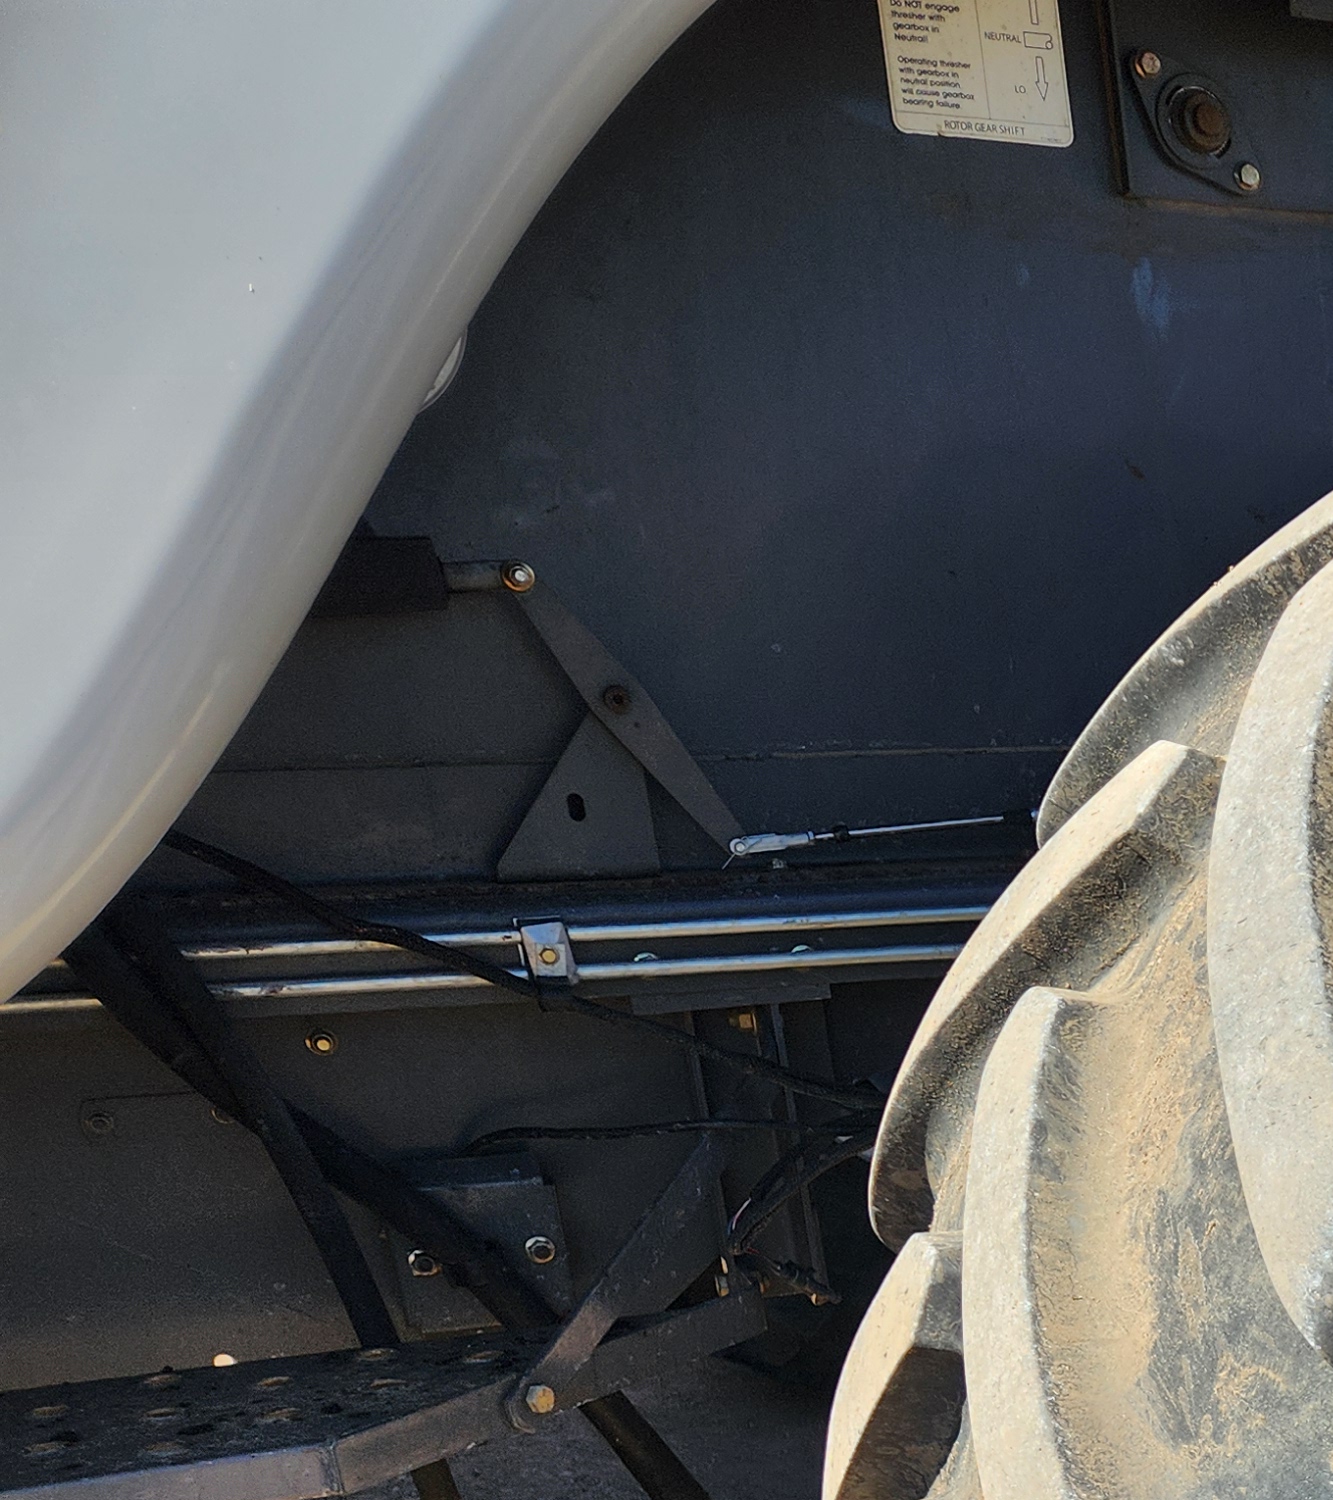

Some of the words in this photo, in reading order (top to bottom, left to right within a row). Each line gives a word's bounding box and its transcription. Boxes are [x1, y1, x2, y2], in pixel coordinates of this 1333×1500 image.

[925, 3, 960, 13] engage
[891, 10, 925, 19] thresher
[928, 13, 946, 22] with
[892, 22, 930, 31] gearbox
[931, 25, 940, 33] in
[984, 31, 1022, 43] NEUTRAL
[897, 55, 938, 67] Operating
[939, 60, 971, 69] thresher
[916, 69, 949, 78] gearbox
[951, 71, 959, 79] in
[900, 77, 928, 85] neutral
[930, 80, 961, 88] position
[915, 88, 940, 96] cause
[942, 91, 974, 100] gearbox
[1014, 85, 1026, 94] LO
[902, 97, 934, 109] bearing
[944, 119, 974, 131] ROTOR
[975, 122, 997, 133] GEAR
[999, 124, 1026, 136] SHIFT
